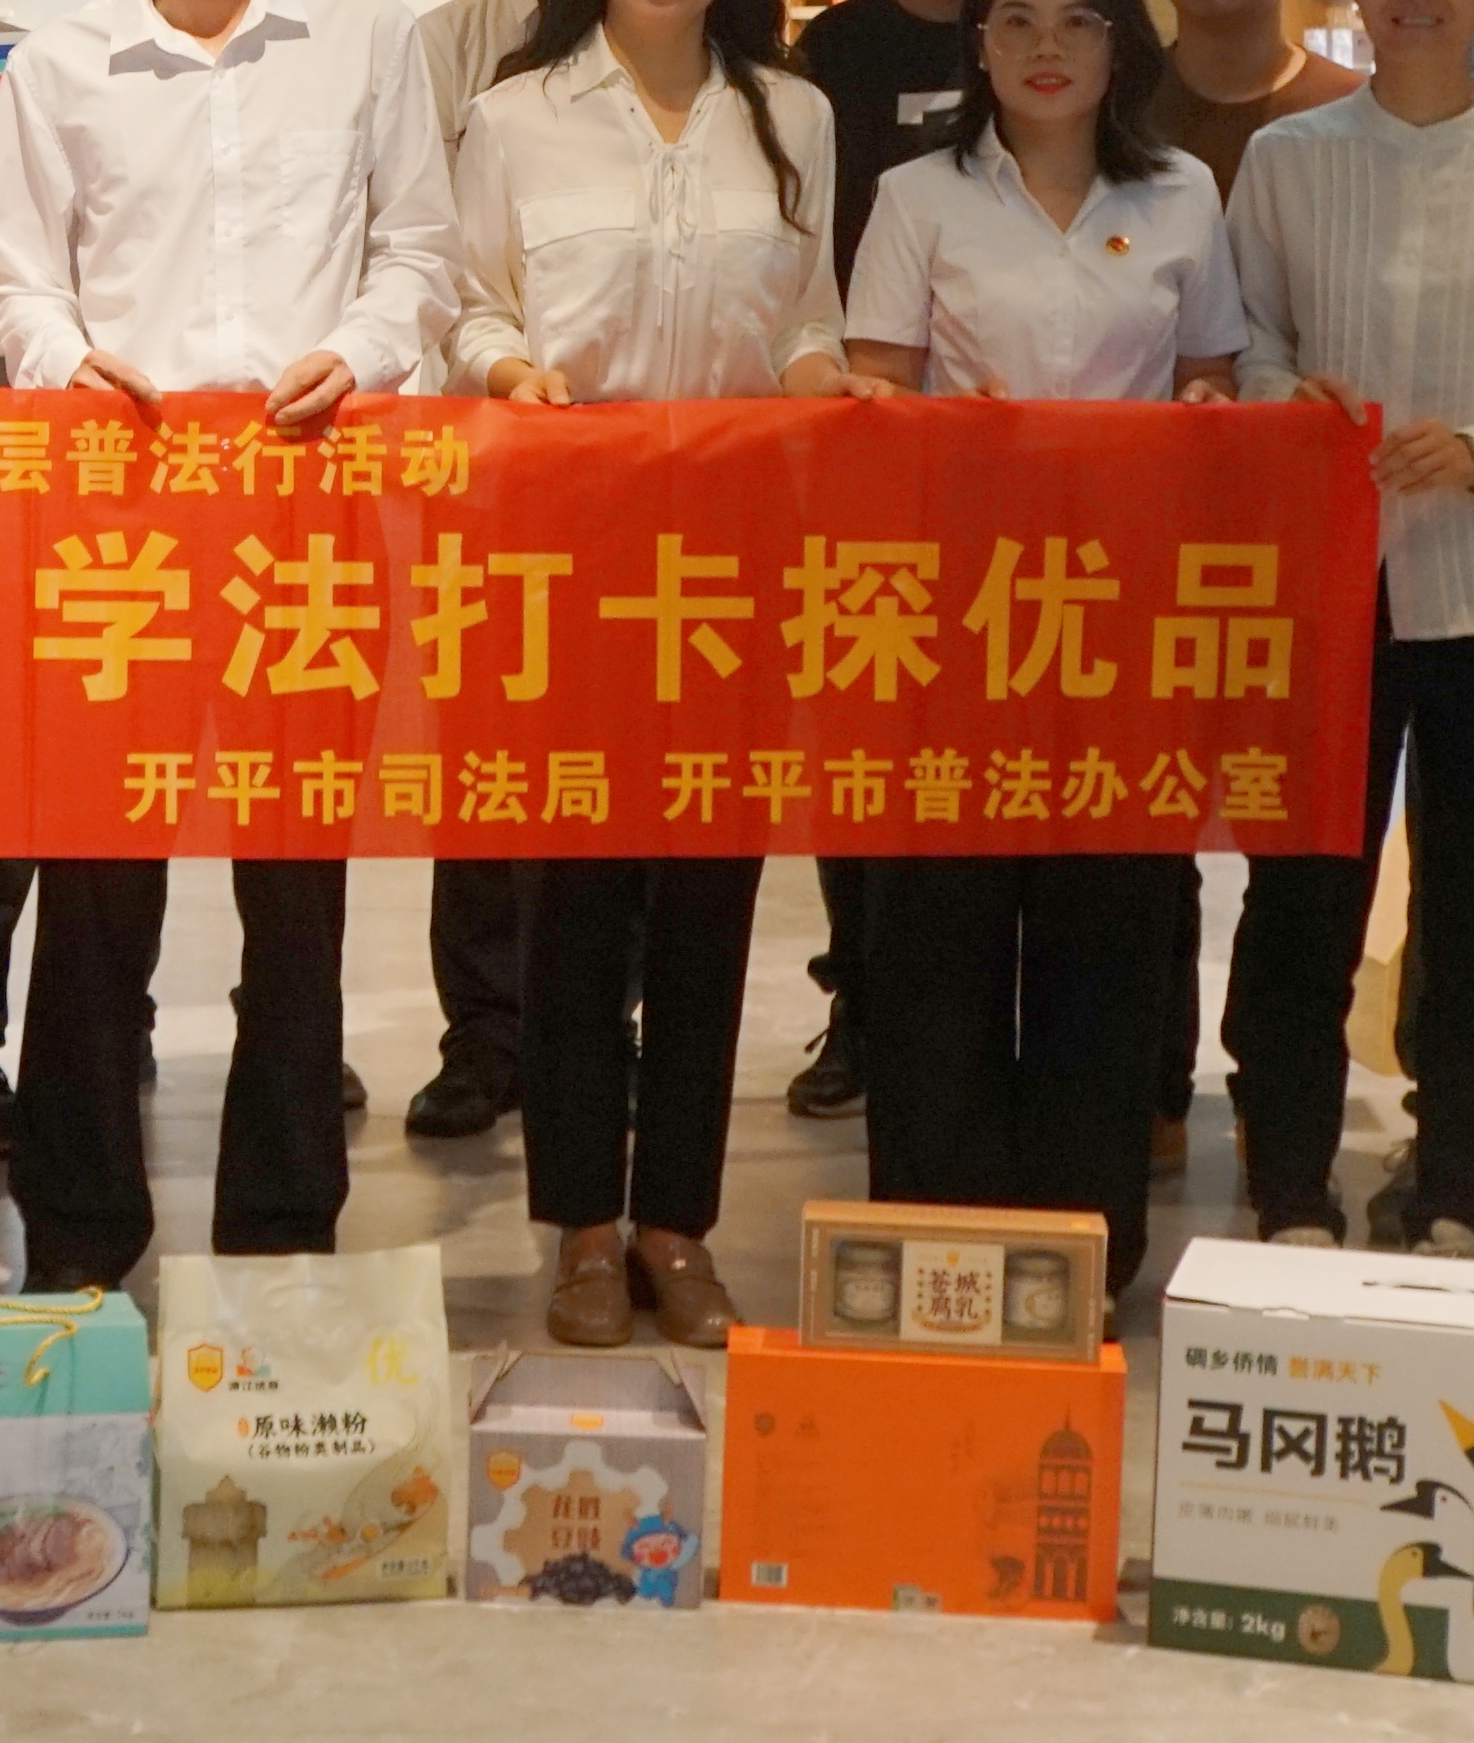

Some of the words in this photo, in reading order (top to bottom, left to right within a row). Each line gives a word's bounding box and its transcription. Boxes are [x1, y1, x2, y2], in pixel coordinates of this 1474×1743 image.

[32, 529, 1296, 703] 学法打卡探优品
[122, 749, 612, 826] 开平市司法局
[660, 747, 1292, 825] 开平市普法办公室
[253, 1411, 369, 1439] 原味濑粉
[1180, 1398, 1407, 1486] 马冈鹅
[1240, 1611, 1287, 1644] 2kg
